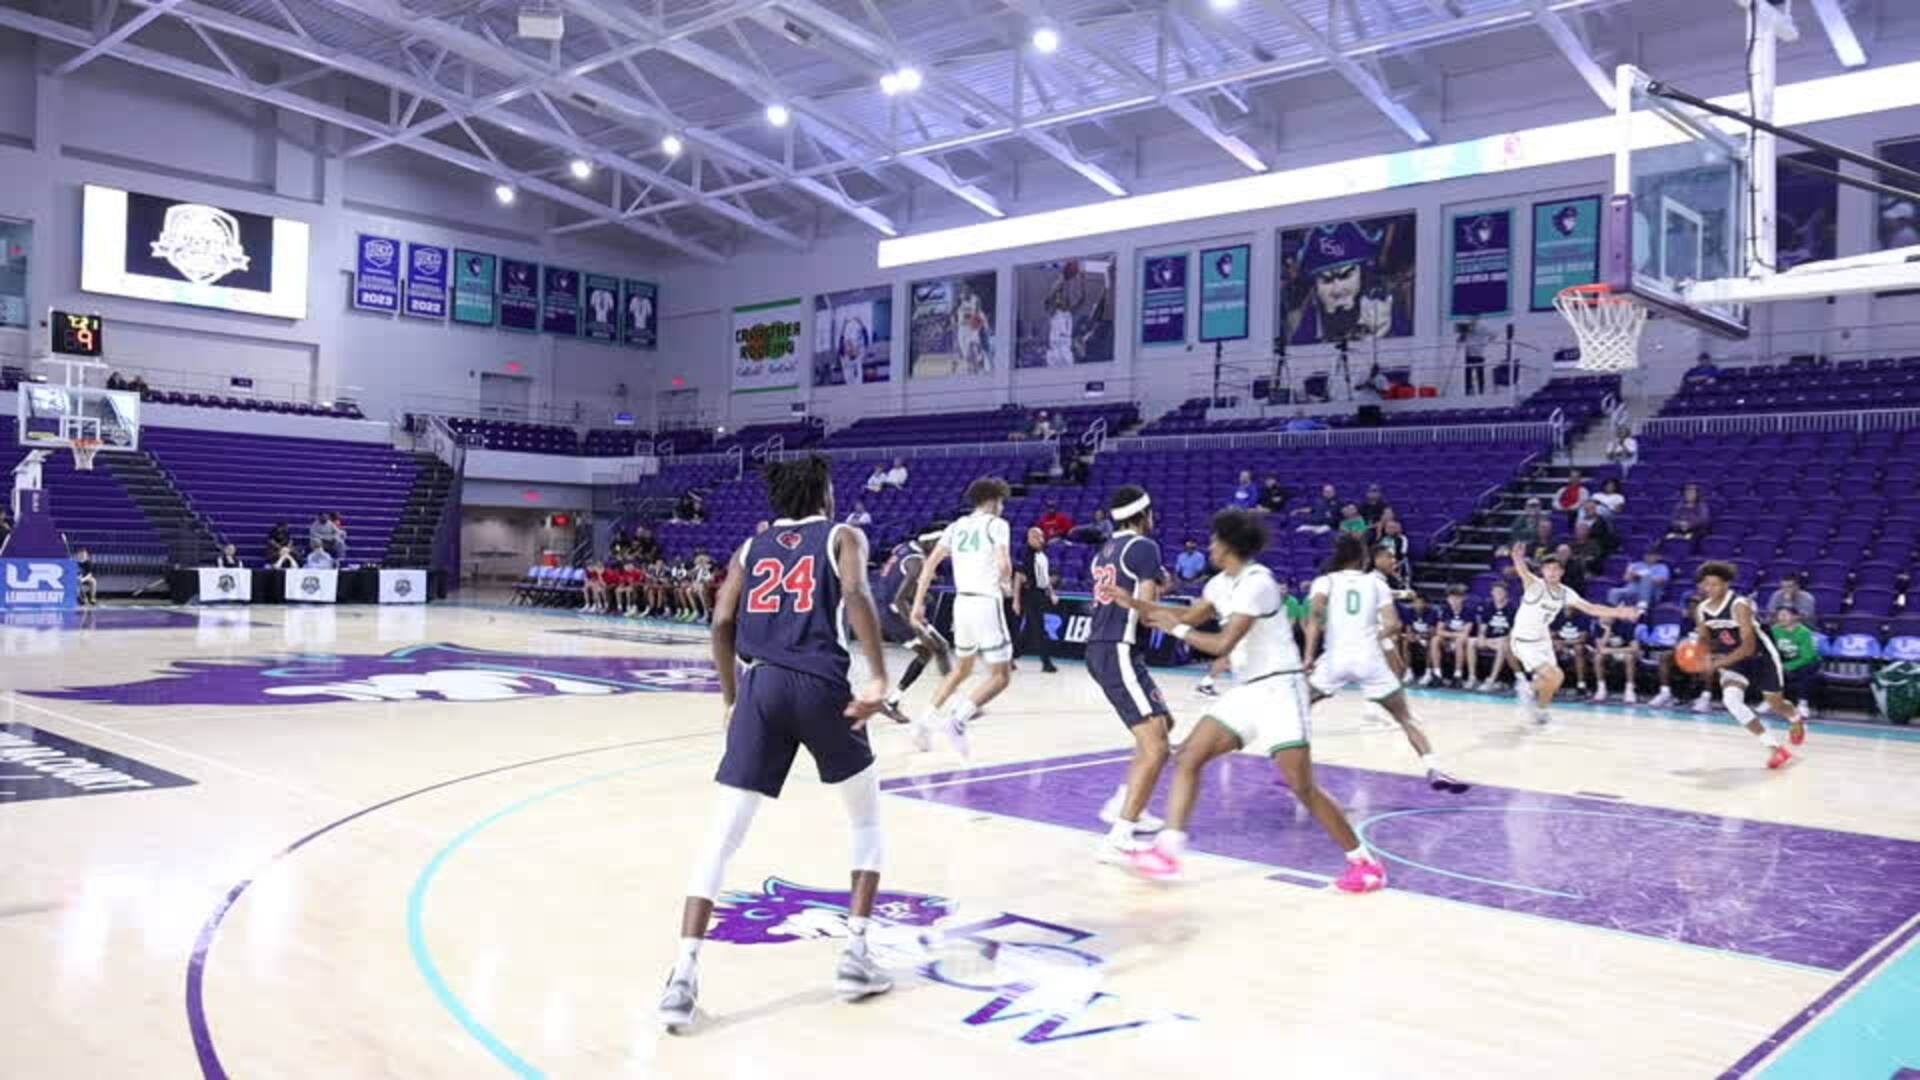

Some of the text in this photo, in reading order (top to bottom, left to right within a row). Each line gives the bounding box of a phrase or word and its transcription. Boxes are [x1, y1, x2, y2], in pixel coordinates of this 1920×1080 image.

[77, 329, 93, 351] 9
[957, 528, 981, 553] 24
[747, 555, 817, 613] 24
[1345, 589, 1361, 615] 0
